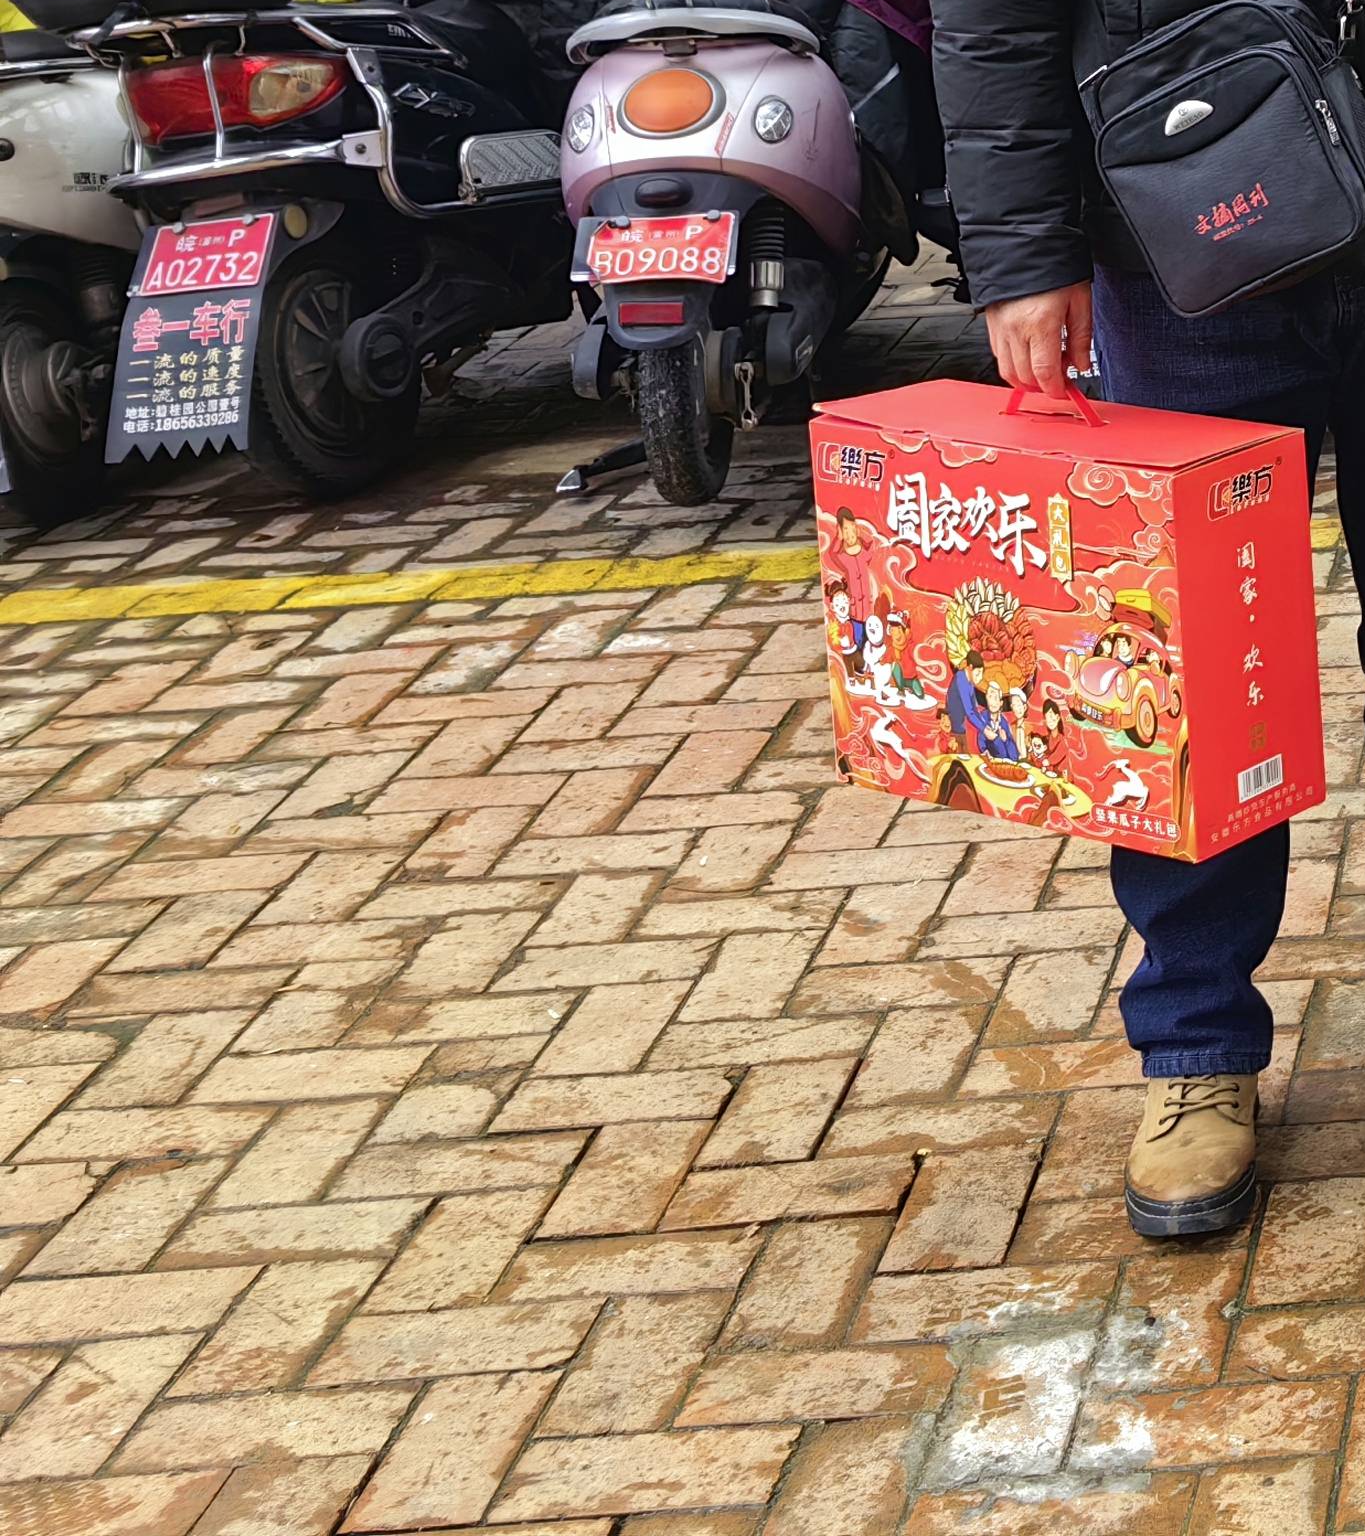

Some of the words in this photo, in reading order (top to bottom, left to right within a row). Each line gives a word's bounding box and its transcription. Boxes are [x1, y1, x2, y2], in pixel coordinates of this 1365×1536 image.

[146, 251, 260, 290] A02732
[128, 347, 245, 370] 一流的质量
[127, 365, 244, 387] 一流的速度
[126, 381, 242, 403] 一流的服务
[123, 411, 239, 434] 电话:18656339286
[1095, 807, 1179, 839] 坚果瓜子大礼包
